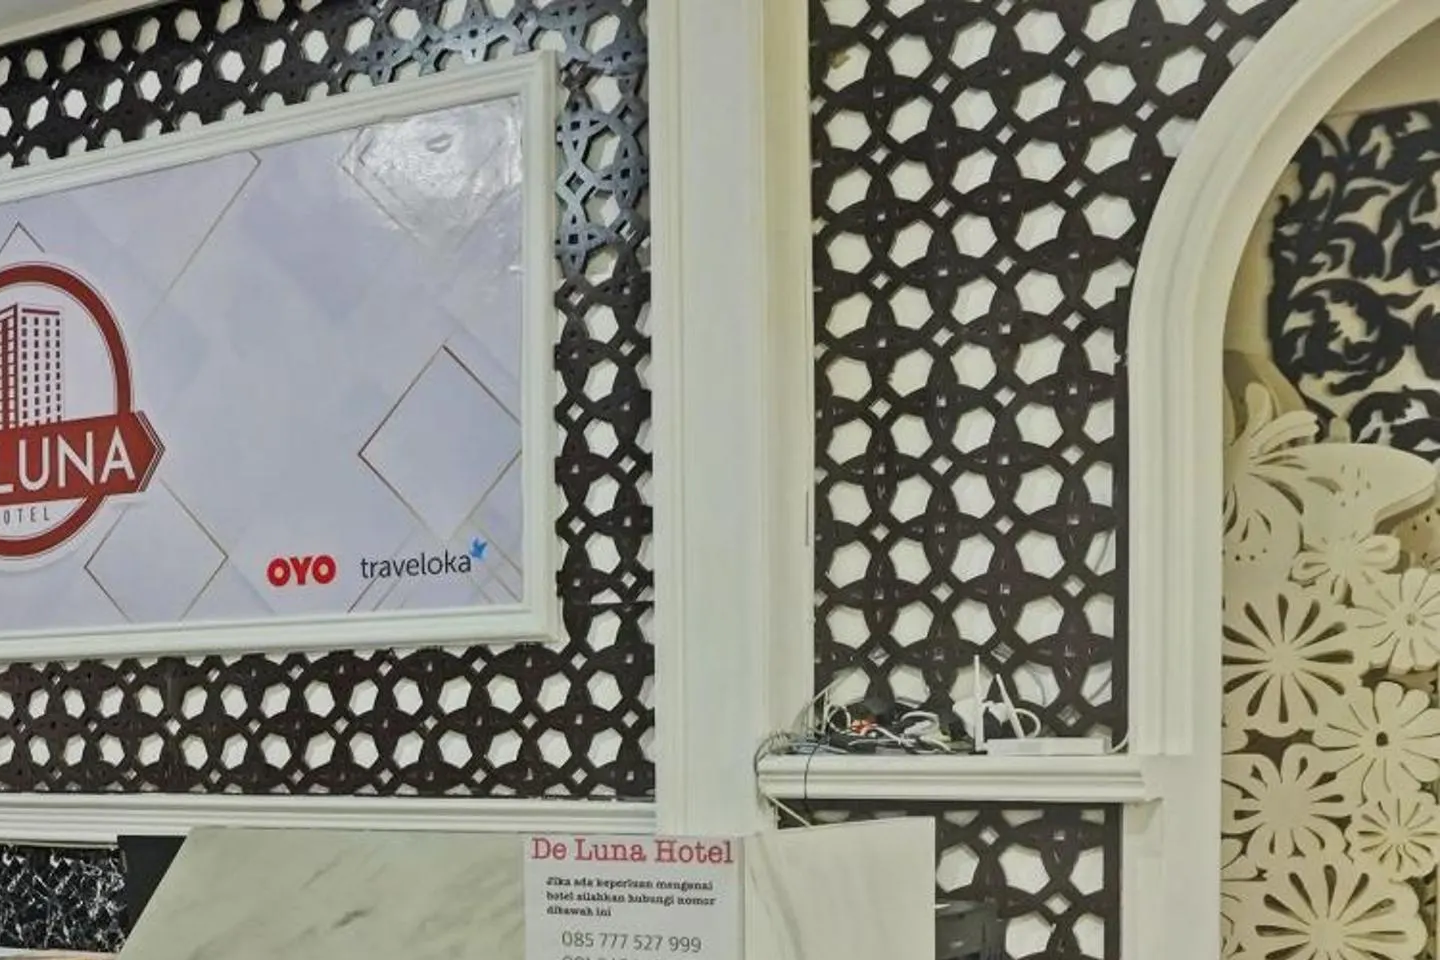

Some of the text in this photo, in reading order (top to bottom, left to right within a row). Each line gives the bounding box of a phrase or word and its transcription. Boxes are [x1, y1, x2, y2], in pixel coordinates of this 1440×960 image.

[266, 554, 337, 587] OYO
[361, 549, 472, 579] traveloka
[532, 838, 734, 864] De Luna Hotel
[573, 877, 593, 887] ada
[562, 931, 702, 953] 085 777 527 999
